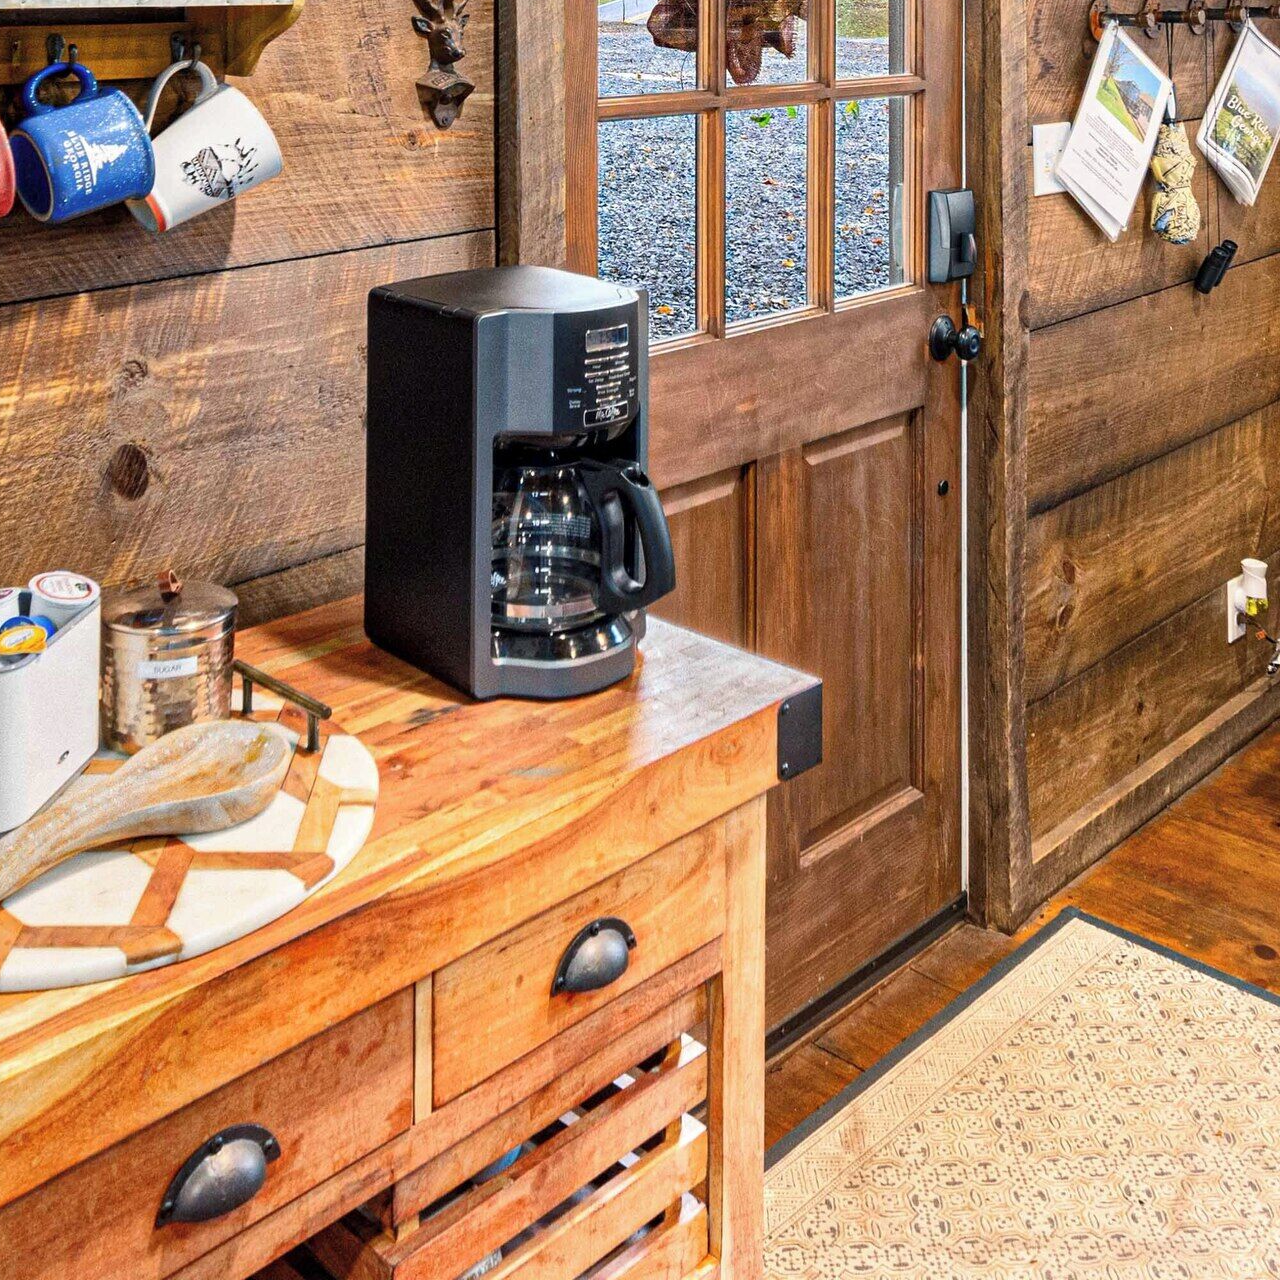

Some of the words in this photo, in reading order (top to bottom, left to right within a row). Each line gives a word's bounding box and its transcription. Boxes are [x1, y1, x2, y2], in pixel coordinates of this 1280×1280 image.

[1226, 94, 1251, 119] Blue
[63, 140, 84, 190] GEORGIA
[67, 130, 85, 158] BLUE
[80, 161, 93, 195] RIDGE
